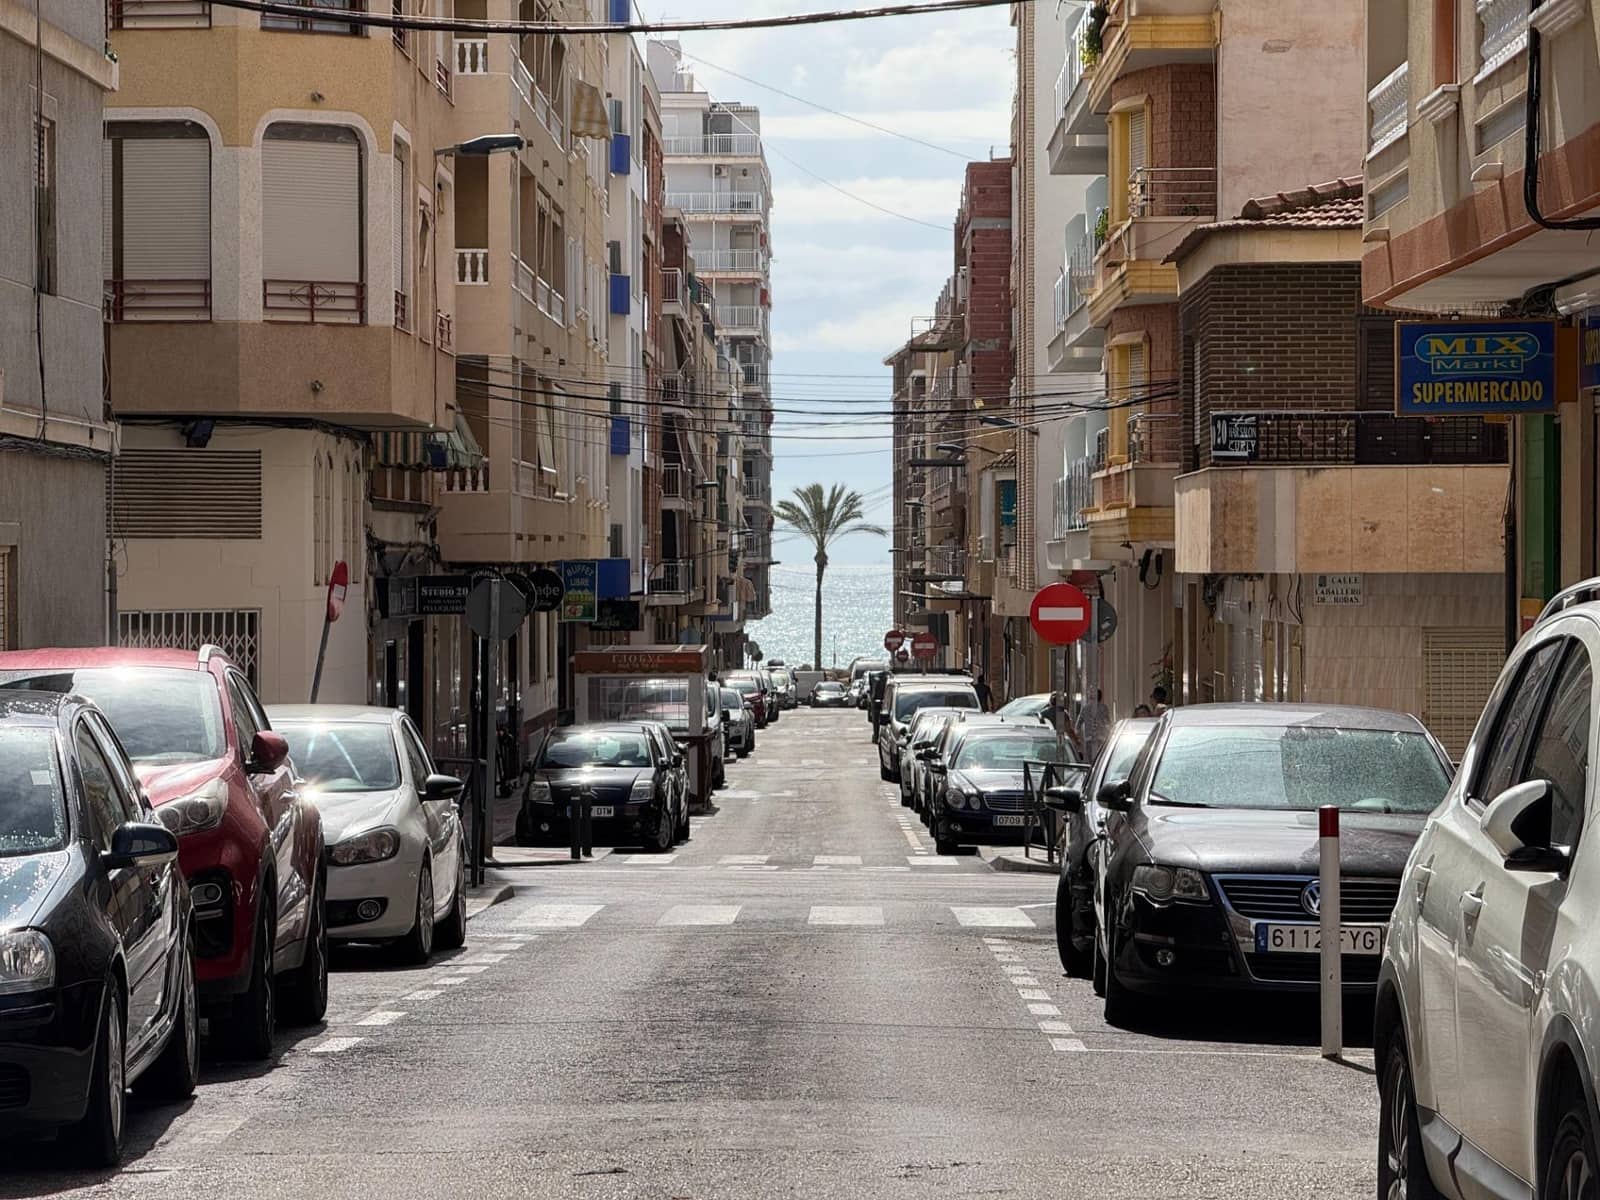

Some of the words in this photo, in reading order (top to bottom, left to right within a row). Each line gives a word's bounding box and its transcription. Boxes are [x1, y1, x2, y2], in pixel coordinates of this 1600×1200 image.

[1425, 337, 1529, 355] MIX
[1435, 358, 1521, 370] Markt
[1412, 380, 1544, 404] SUPERMERCADO
[566, 564, 594, 577] BUFFET
[1331, 576, 1360, 584] CALLE
[455, 587, 469, 596] 20
